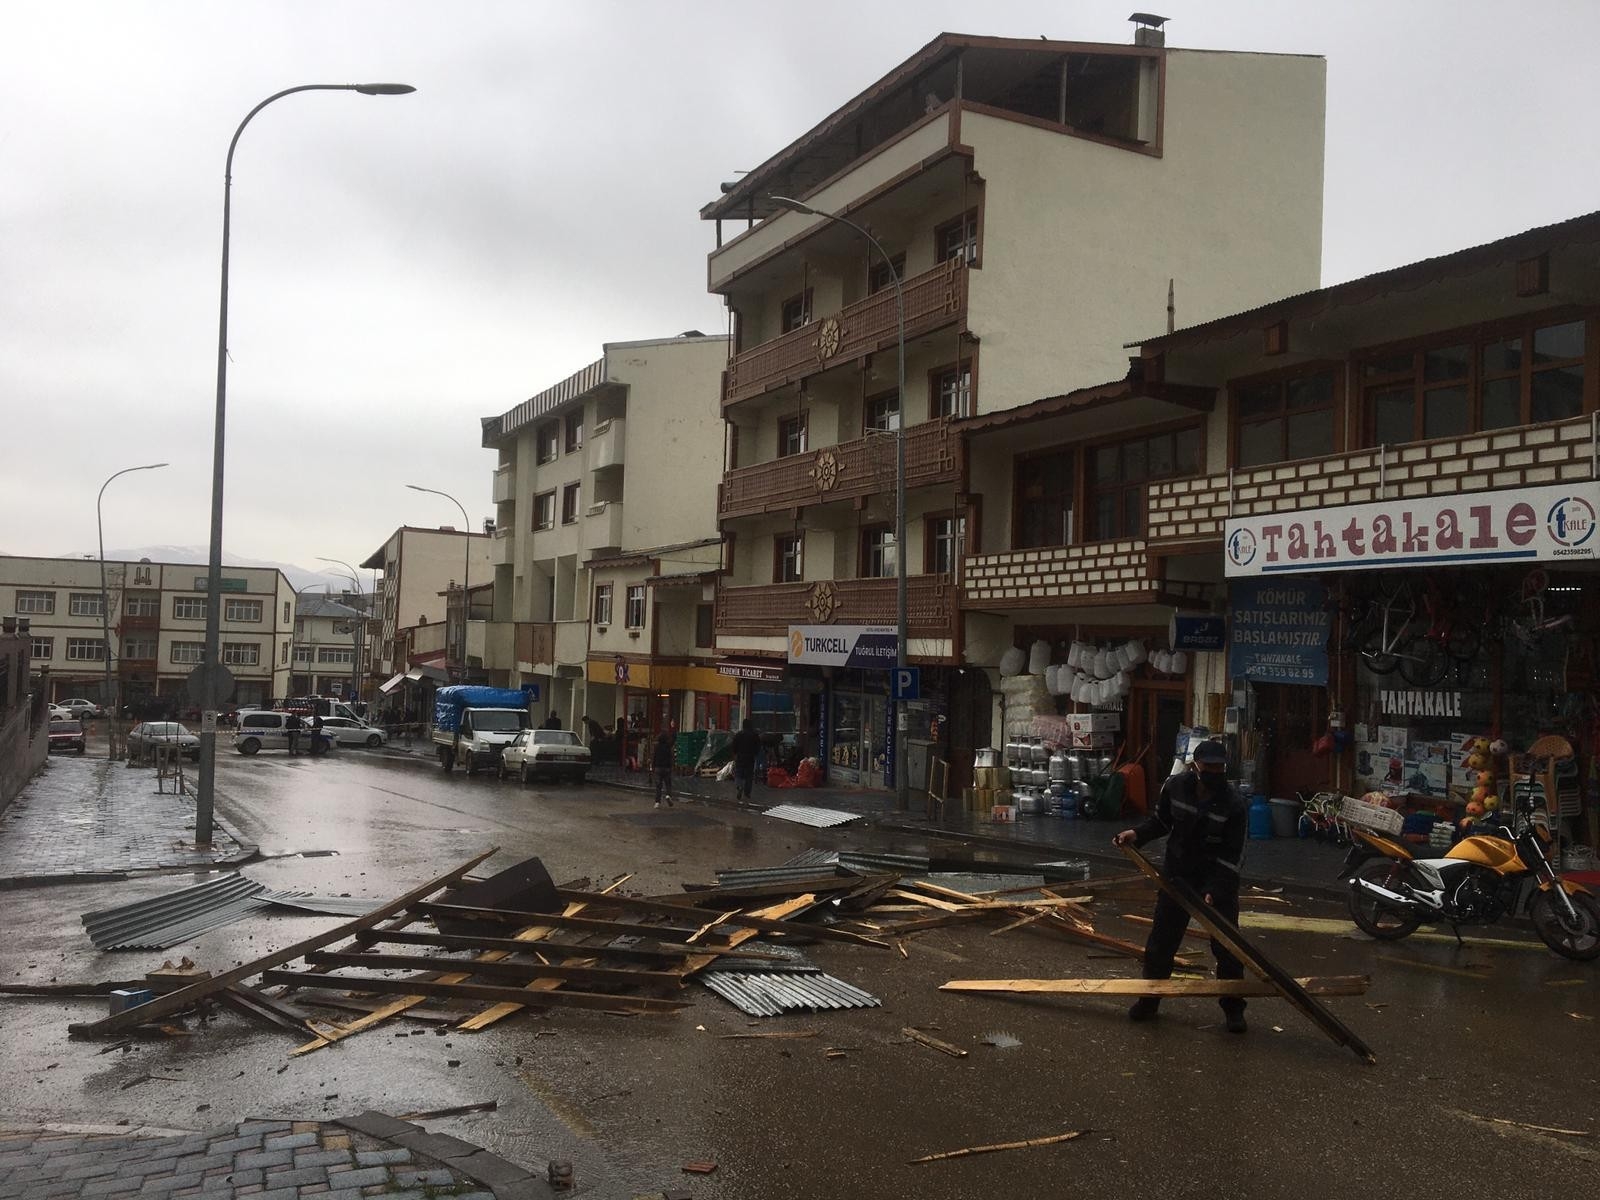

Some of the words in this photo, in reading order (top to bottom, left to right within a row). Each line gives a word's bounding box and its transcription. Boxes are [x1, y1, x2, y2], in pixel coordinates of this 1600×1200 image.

[1262, 503, 1536, 561] Tahtakale
[1256, 588, 1306, 605] KÖMÜR
[805, 637, 848, 653] TURKCELL
[898, 671, 912, 697] P
[1380, 690, 1462, 717] TAHTAKALE
